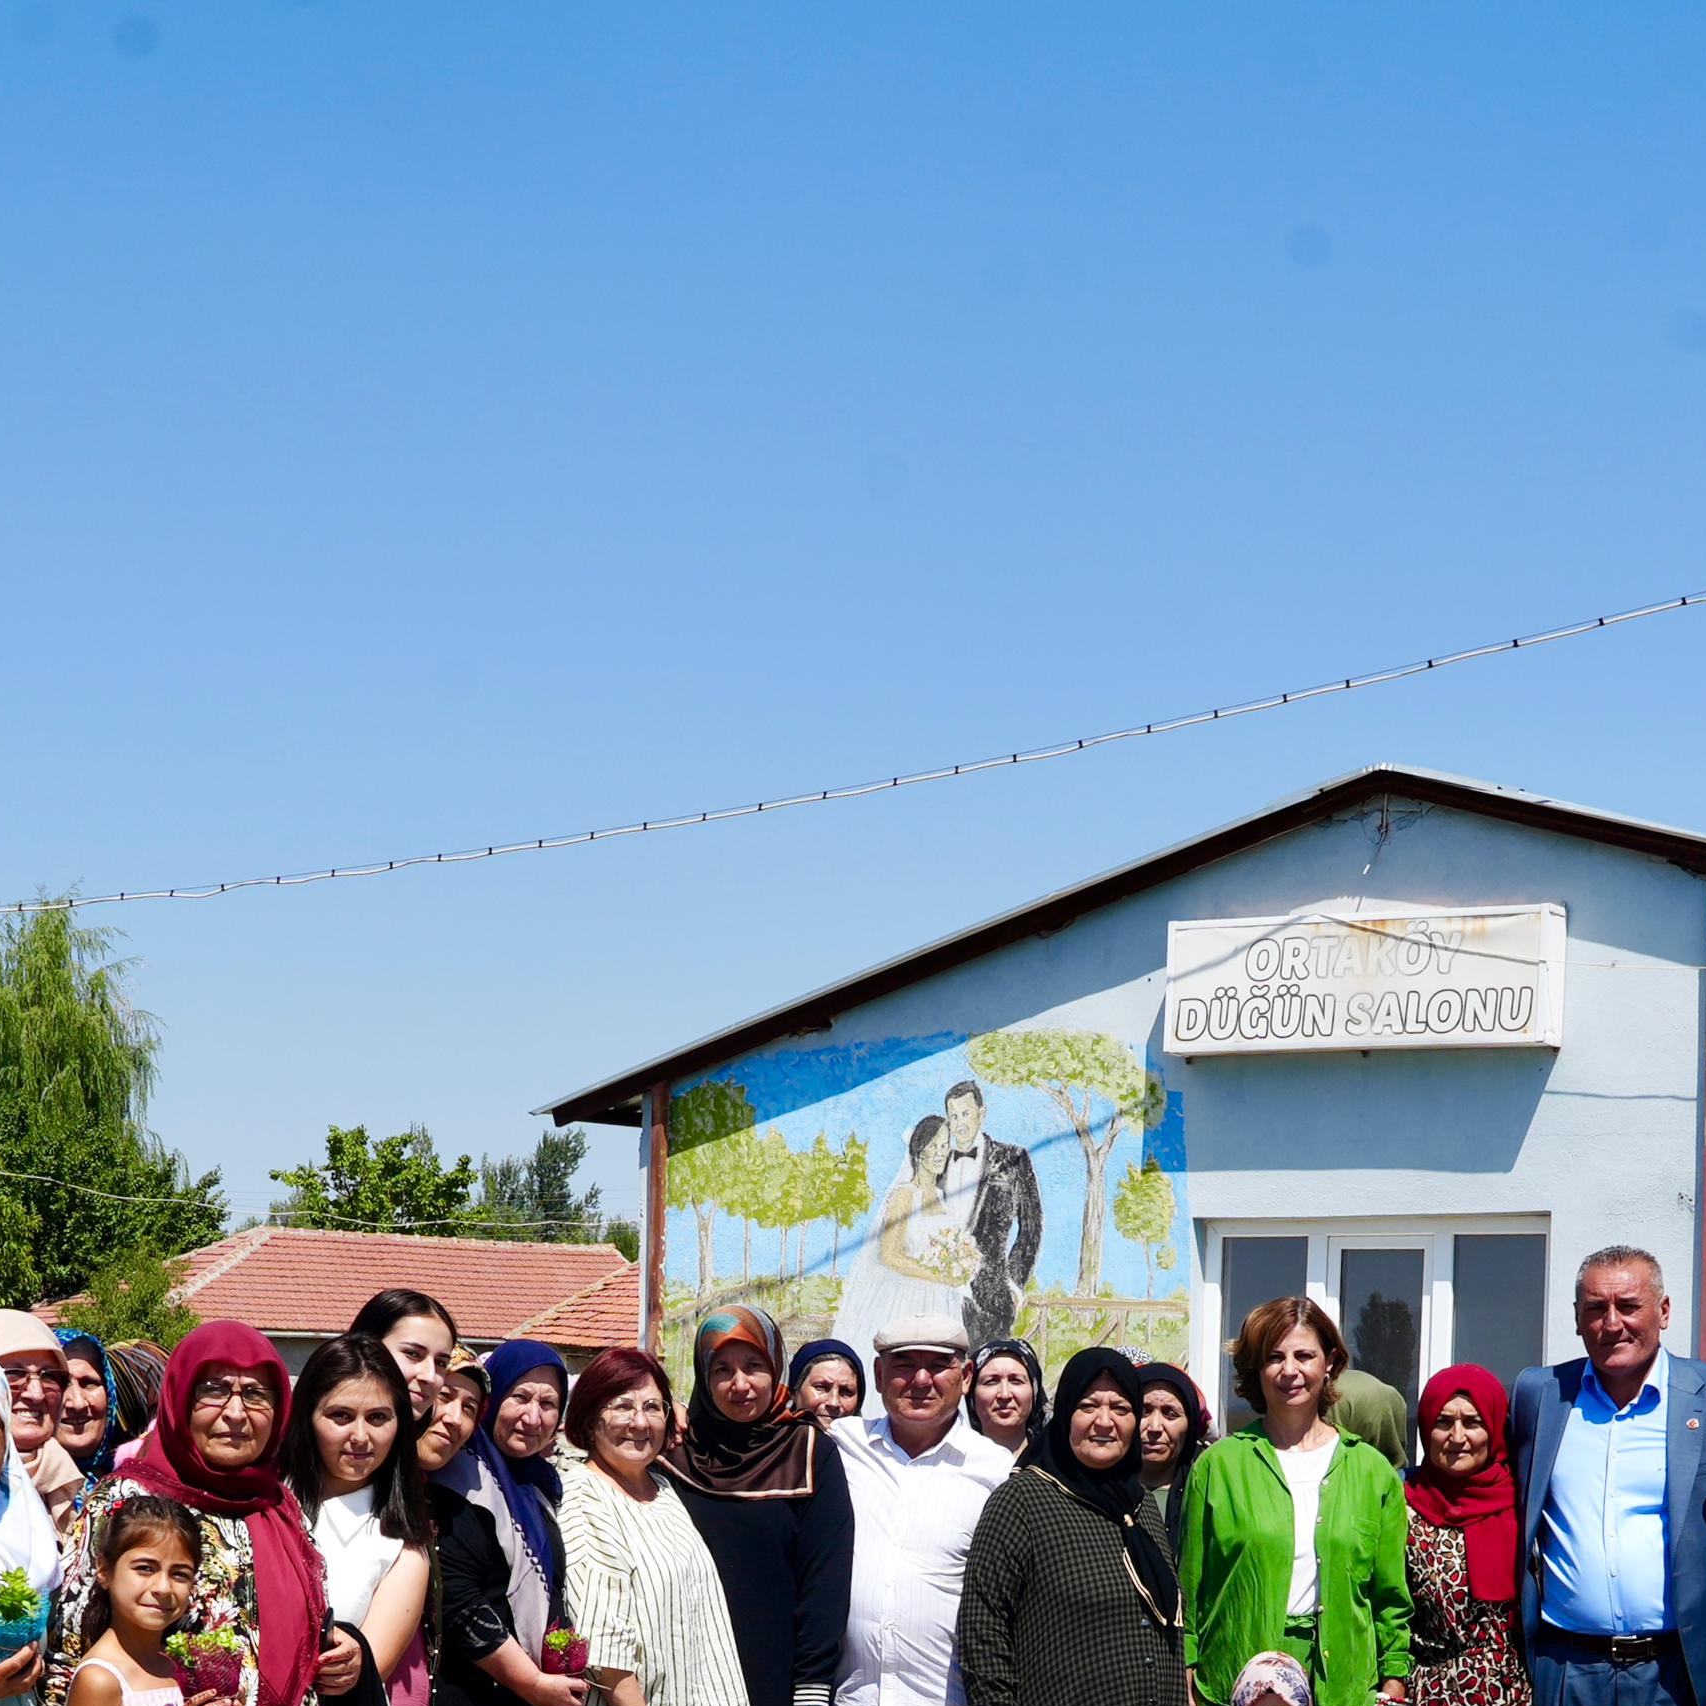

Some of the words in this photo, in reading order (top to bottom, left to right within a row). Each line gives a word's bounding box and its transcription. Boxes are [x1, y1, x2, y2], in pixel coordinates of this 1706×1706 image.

[1245, 920, 1463, 982] ORTAKÖY
[1175, 983, 1337, 1041] DÜĞÜN
[1345, 986, 1534, 1037] SALONU
